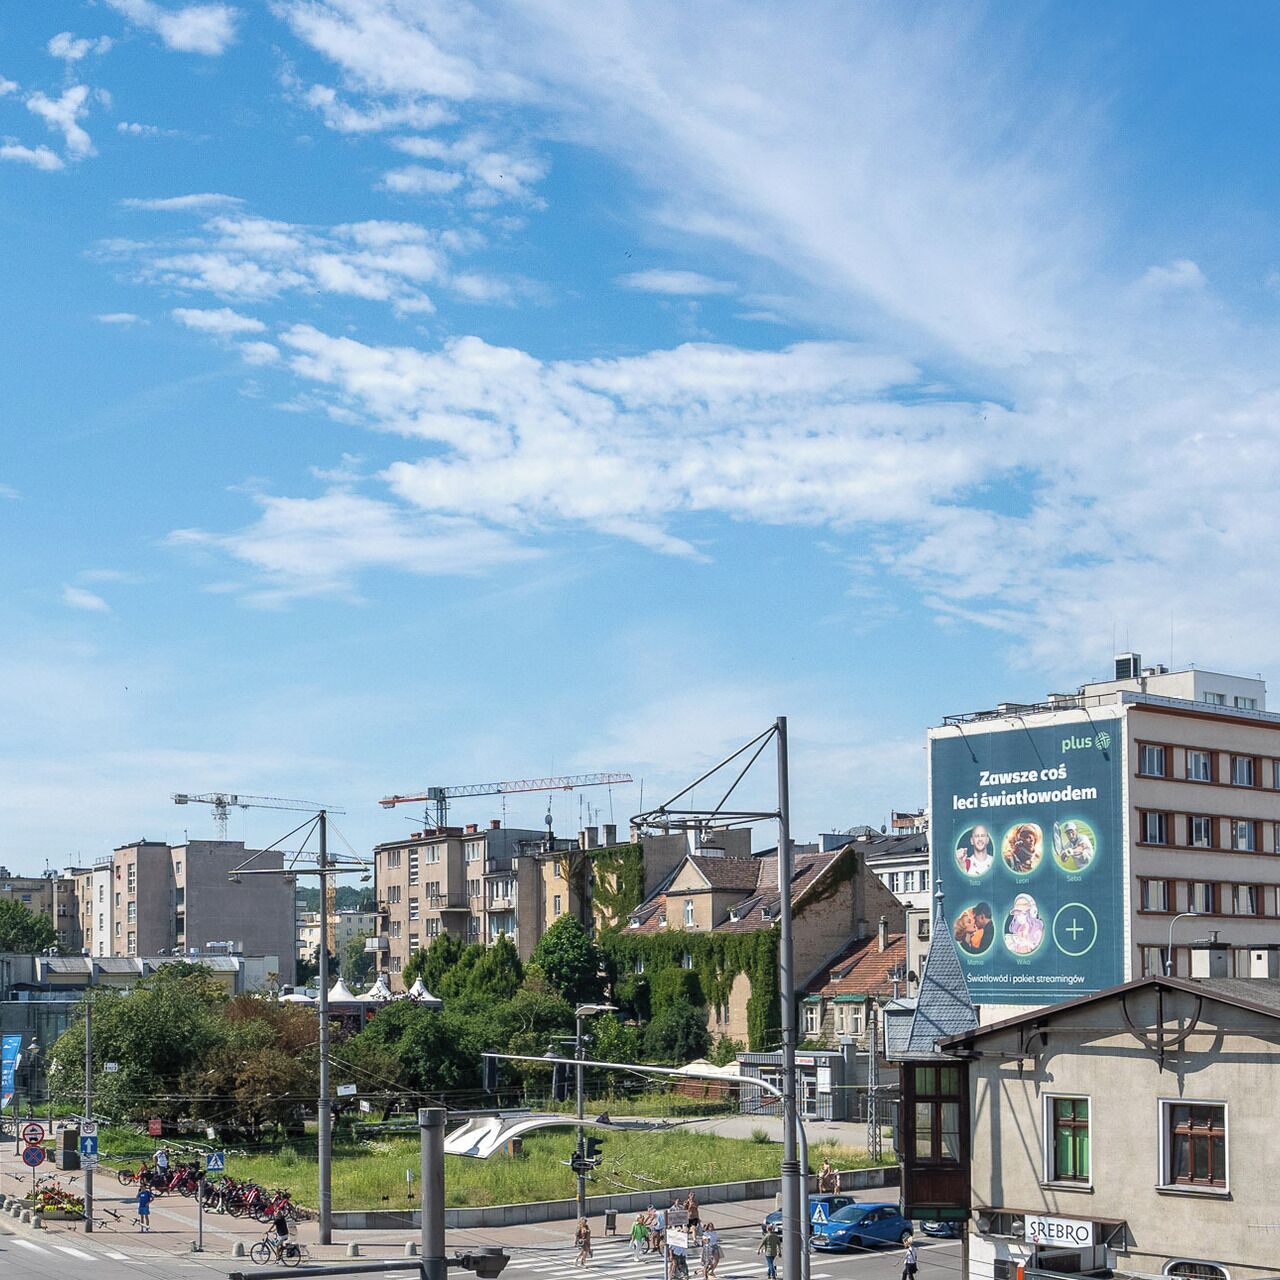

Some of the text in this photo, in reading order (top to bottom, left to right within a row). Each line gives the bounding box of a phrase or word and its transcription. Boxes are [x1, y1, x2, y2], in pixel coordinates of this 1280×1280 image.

[1061, 736, 1092, 753] plus
[980, 763, 1067, 786] Zawsze coś
[953, 785, 1097, 810] leci światłowodem
[1016, 877, 1029, 885] Leon
[967, 972, 1008, 983] Światłowód
[1013, 973, 1035, 985] pakiet
[1036, 974, 1085, 986] streamingów
[1030, 1221, 1089, 1245] SREBRO
